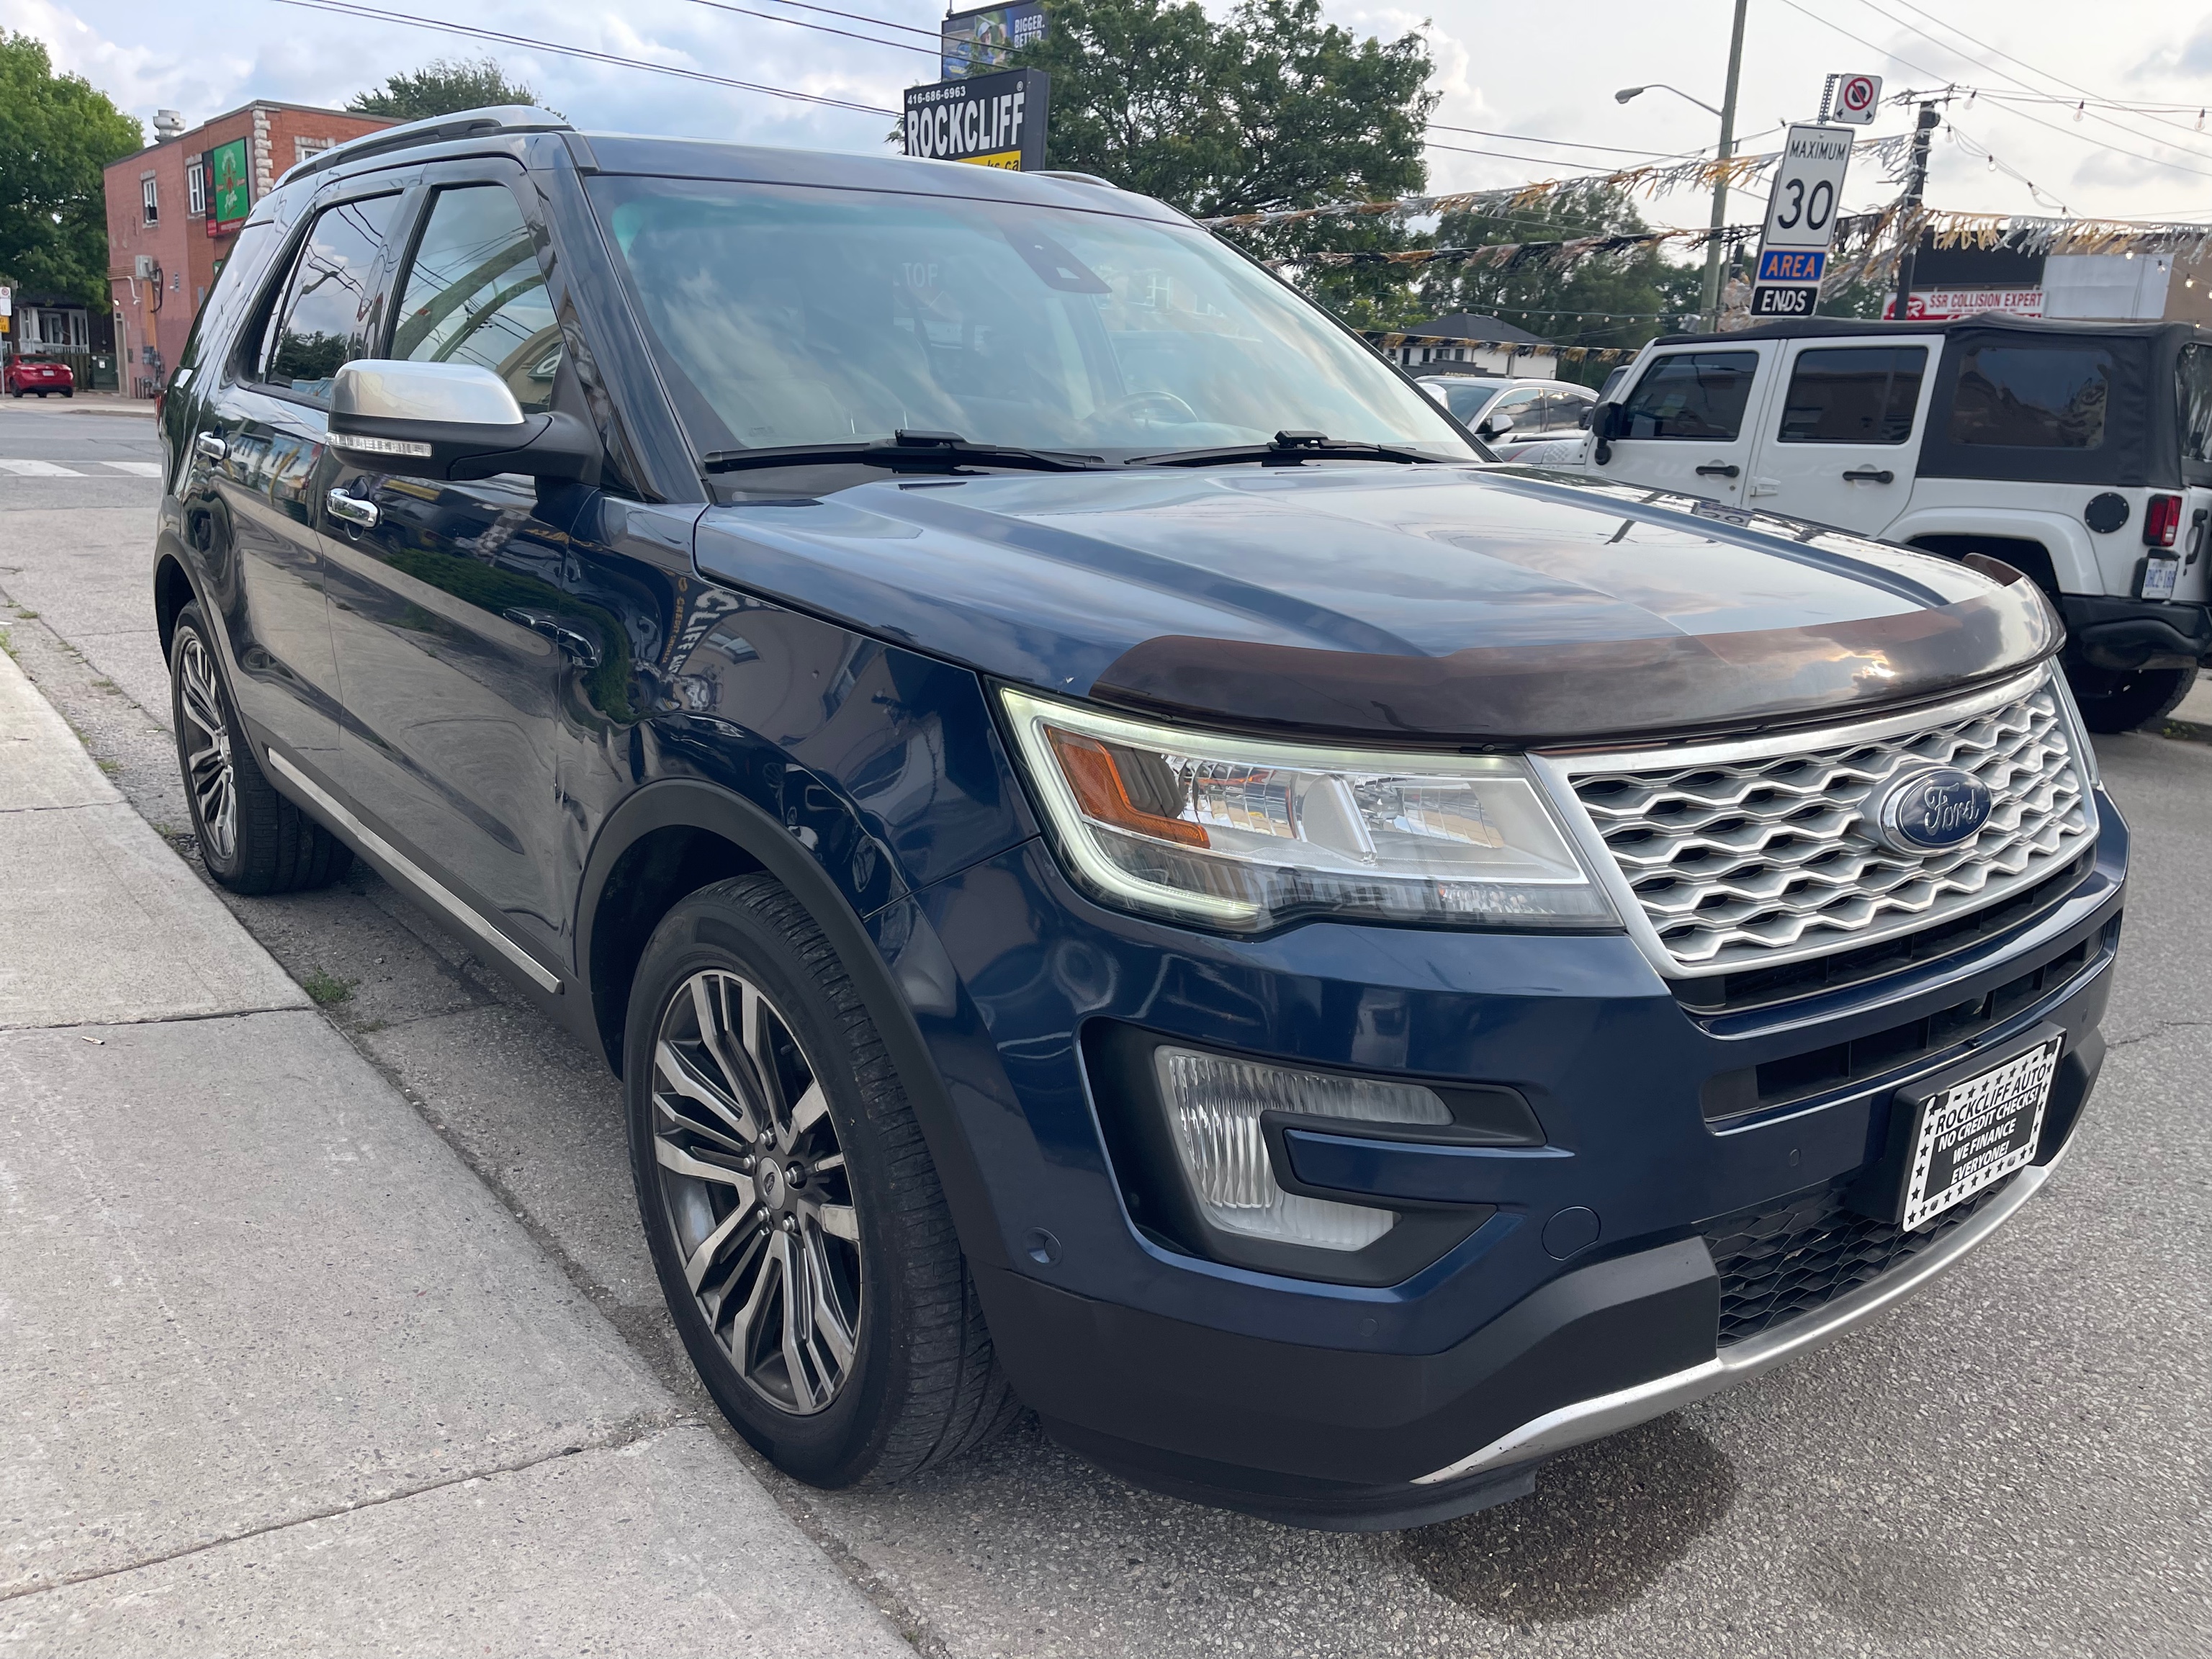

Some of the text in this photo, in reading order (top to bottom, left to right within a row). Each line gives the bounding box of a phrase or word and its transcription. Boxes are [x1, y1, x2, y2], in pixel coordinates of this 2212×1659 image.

[1015, 14, 1045, 34] BIGGER.
[907, 85, 966, 105] 416-686-6963
[907, 91, 1025, 158] ROCKCLIFF
[1789, 139, 1846, 161] MAXIMUM
[1778, 178, 1833, 230] 30
[1766, 255, 1815, 278] AREA
[1761, 289, 1807, 312] ENDS
[1929, 294, 1948, 307] SSR
[1951, 293, 2002, 307] COLLISION
[2004, 292, 2043, 307] EXPERT
[1924, 782, 1979, 836] Ford
[1937, 1064, 2046, 1132] ROCKCLIFF AUTO
[1938, 1087, 2038, 1153] NO CREDIT CHECKS!
[1951, 1140, 2010, 1186] EVERYONE!
[1952, 1118, 2017, 1165] WE FINANCE
